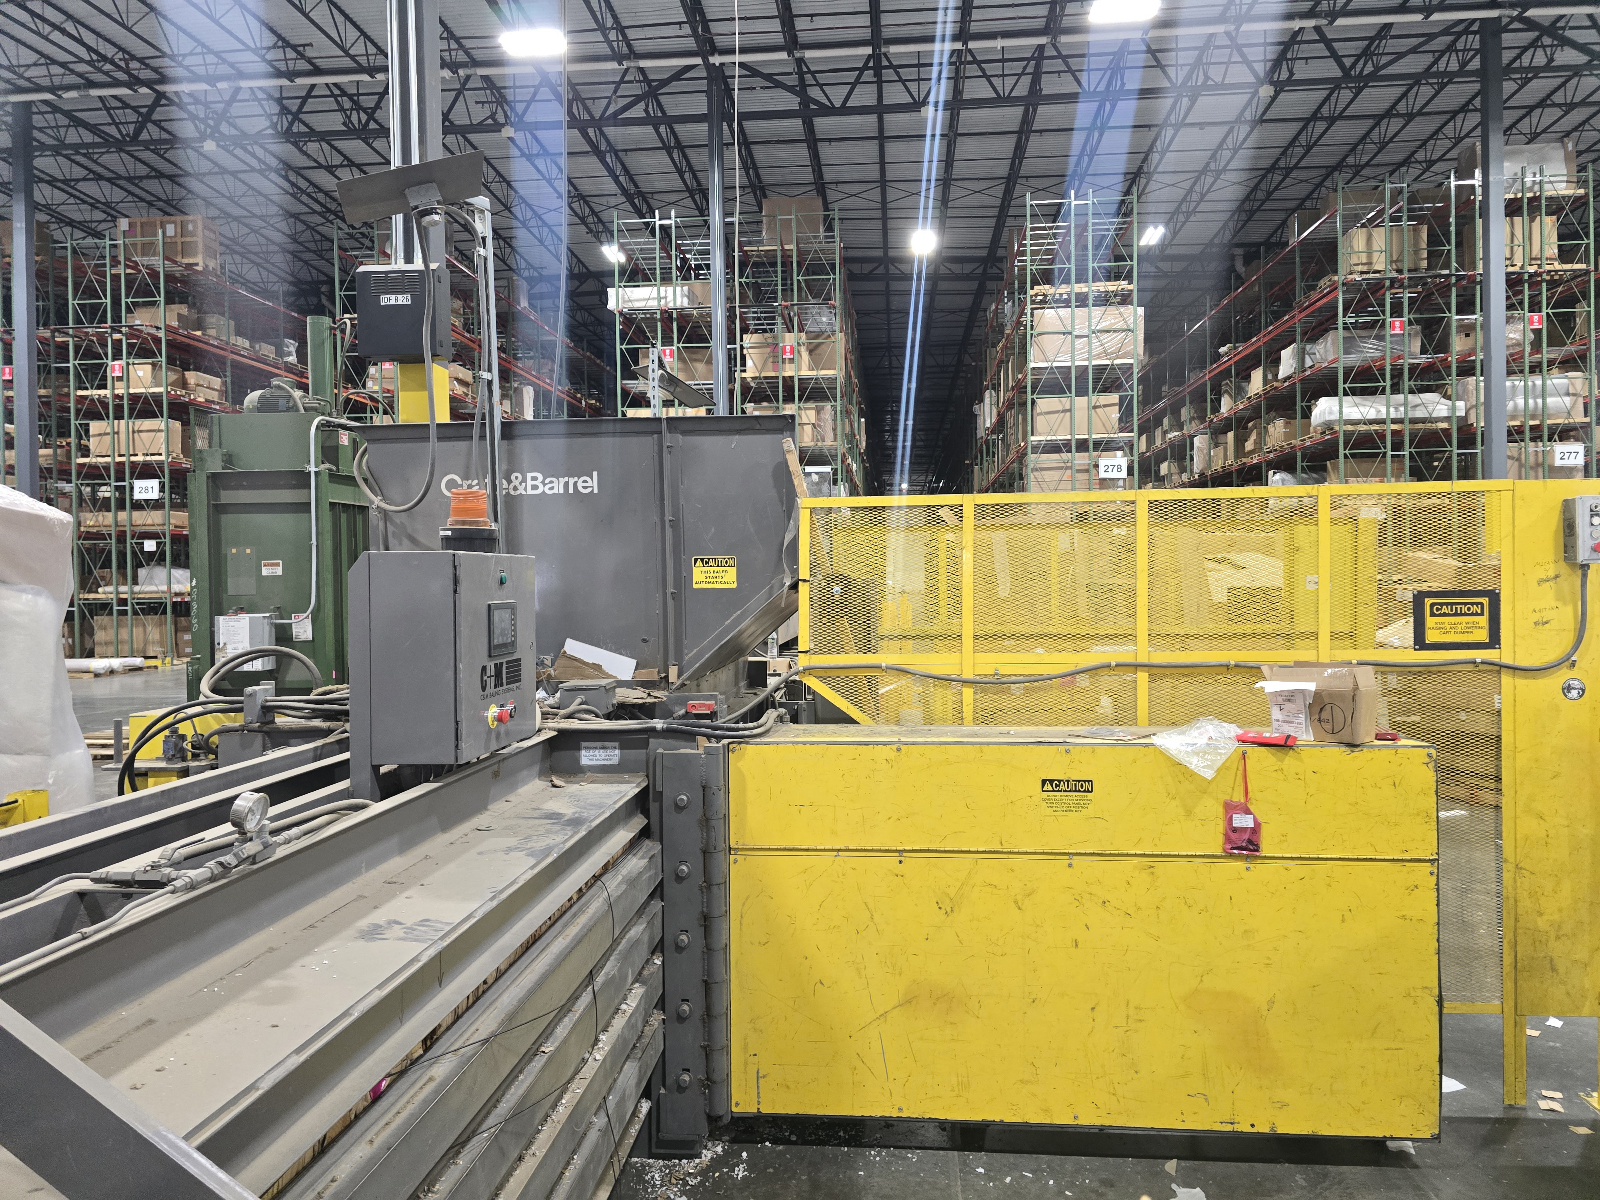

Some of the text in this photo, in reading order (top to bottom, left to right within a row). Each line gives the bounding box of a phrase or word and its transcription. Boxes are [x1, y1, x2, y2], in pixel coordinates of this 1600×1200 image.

[381, 296, 392, 304] IDF
[1559, 451, 1579, 460] 277
[1103, 464, 1123, 473] 278
[138, 486, 154, 494] 281
[703, 558, 735, 567] CAUTION
[1433, 604, 1481, 614] CAUTION
[1052, 781, 1092, 791] CAUTION
